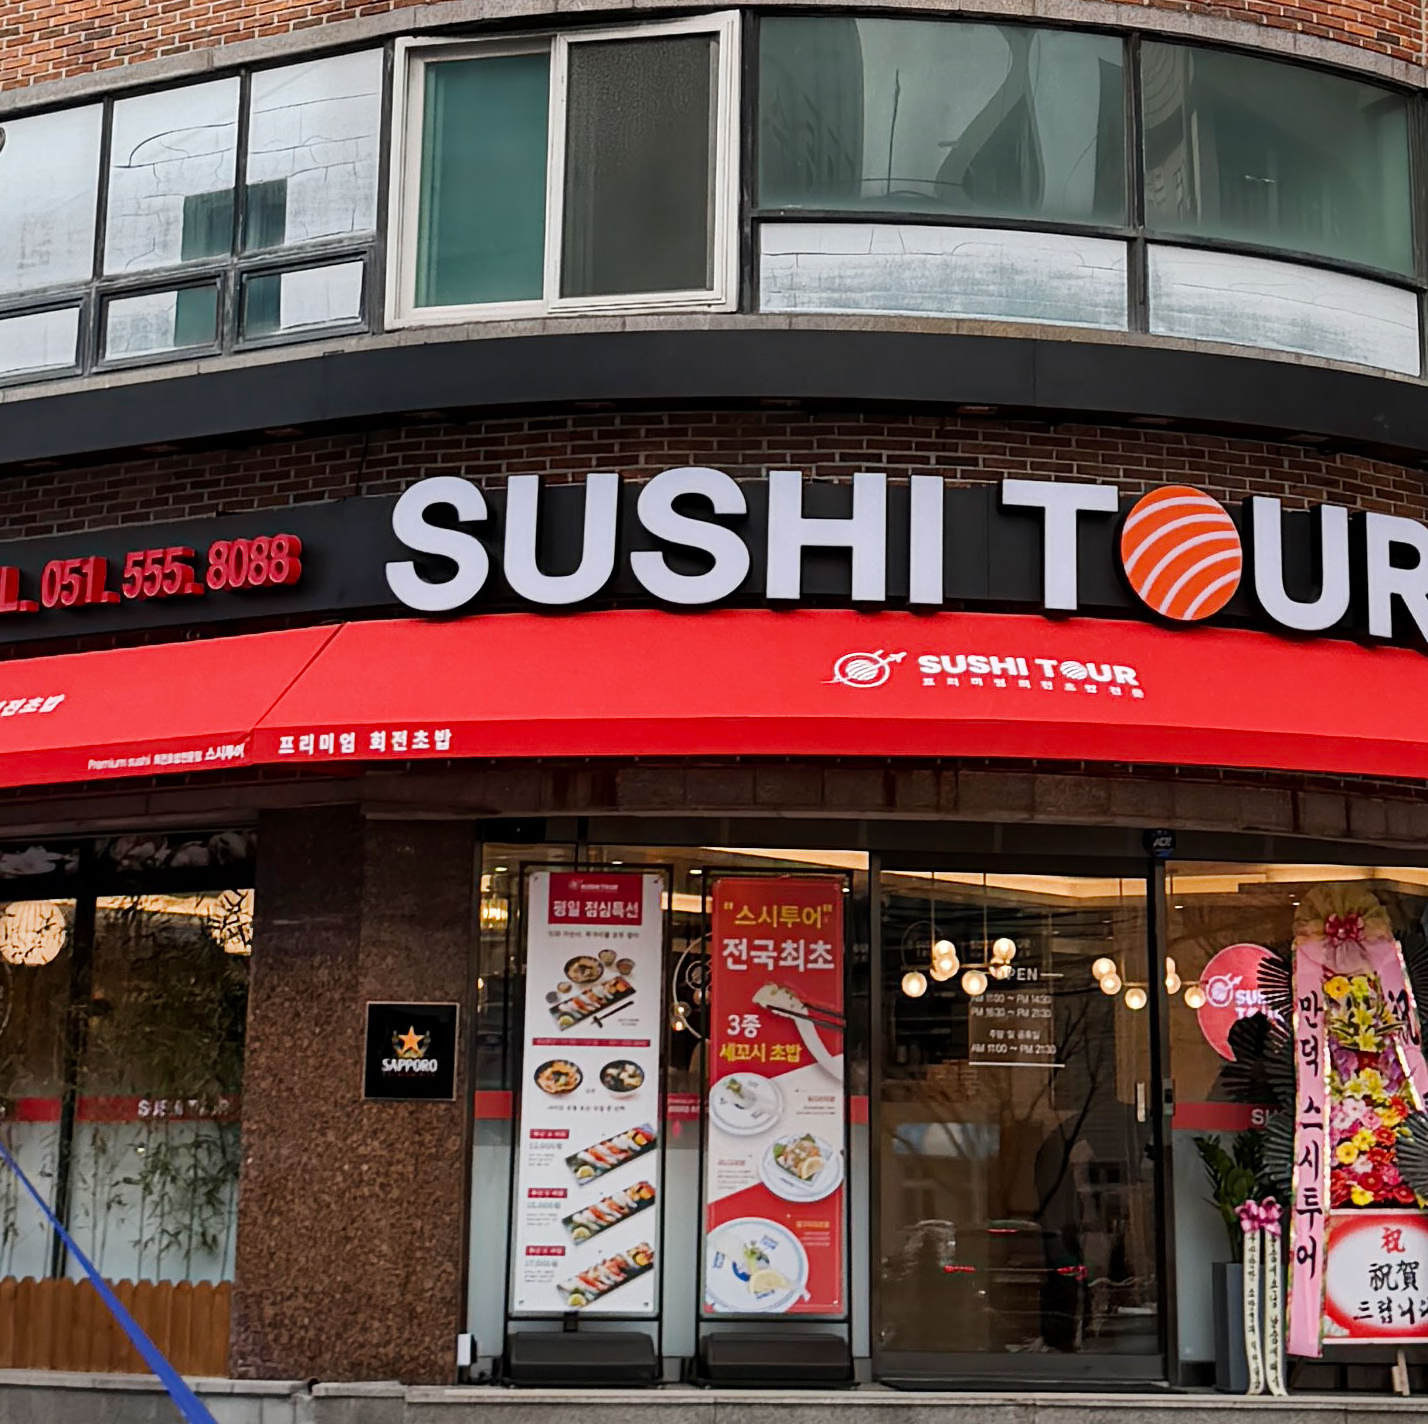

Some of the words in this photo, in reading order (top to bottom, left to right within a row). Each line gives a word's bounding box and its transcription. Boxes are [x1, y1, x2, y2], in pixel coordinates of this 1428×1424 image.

[385, 466, 945, 613] SUSHI
[207, 533, 302, 591] 8088
[918, 654, 1029, 676] SUSHI
[1035, 658, 1141, 687] TOUR
[278, 731, 356, 756] 프리미엄
[369, 728, 453, 753] 회전초밥
[553, 900, 580, 918] 평일
[722, 938, 836, 973] 전국최초
[727, 1014, 762, 1039] 3종
[1298, 990, 1324, 1078] 만덕
[381, 1058, 438, 1073] SAPPORO
[769, 1043, 803, 1063] 초밥
[1296, 1095, 1324, 1279] 스시투어
